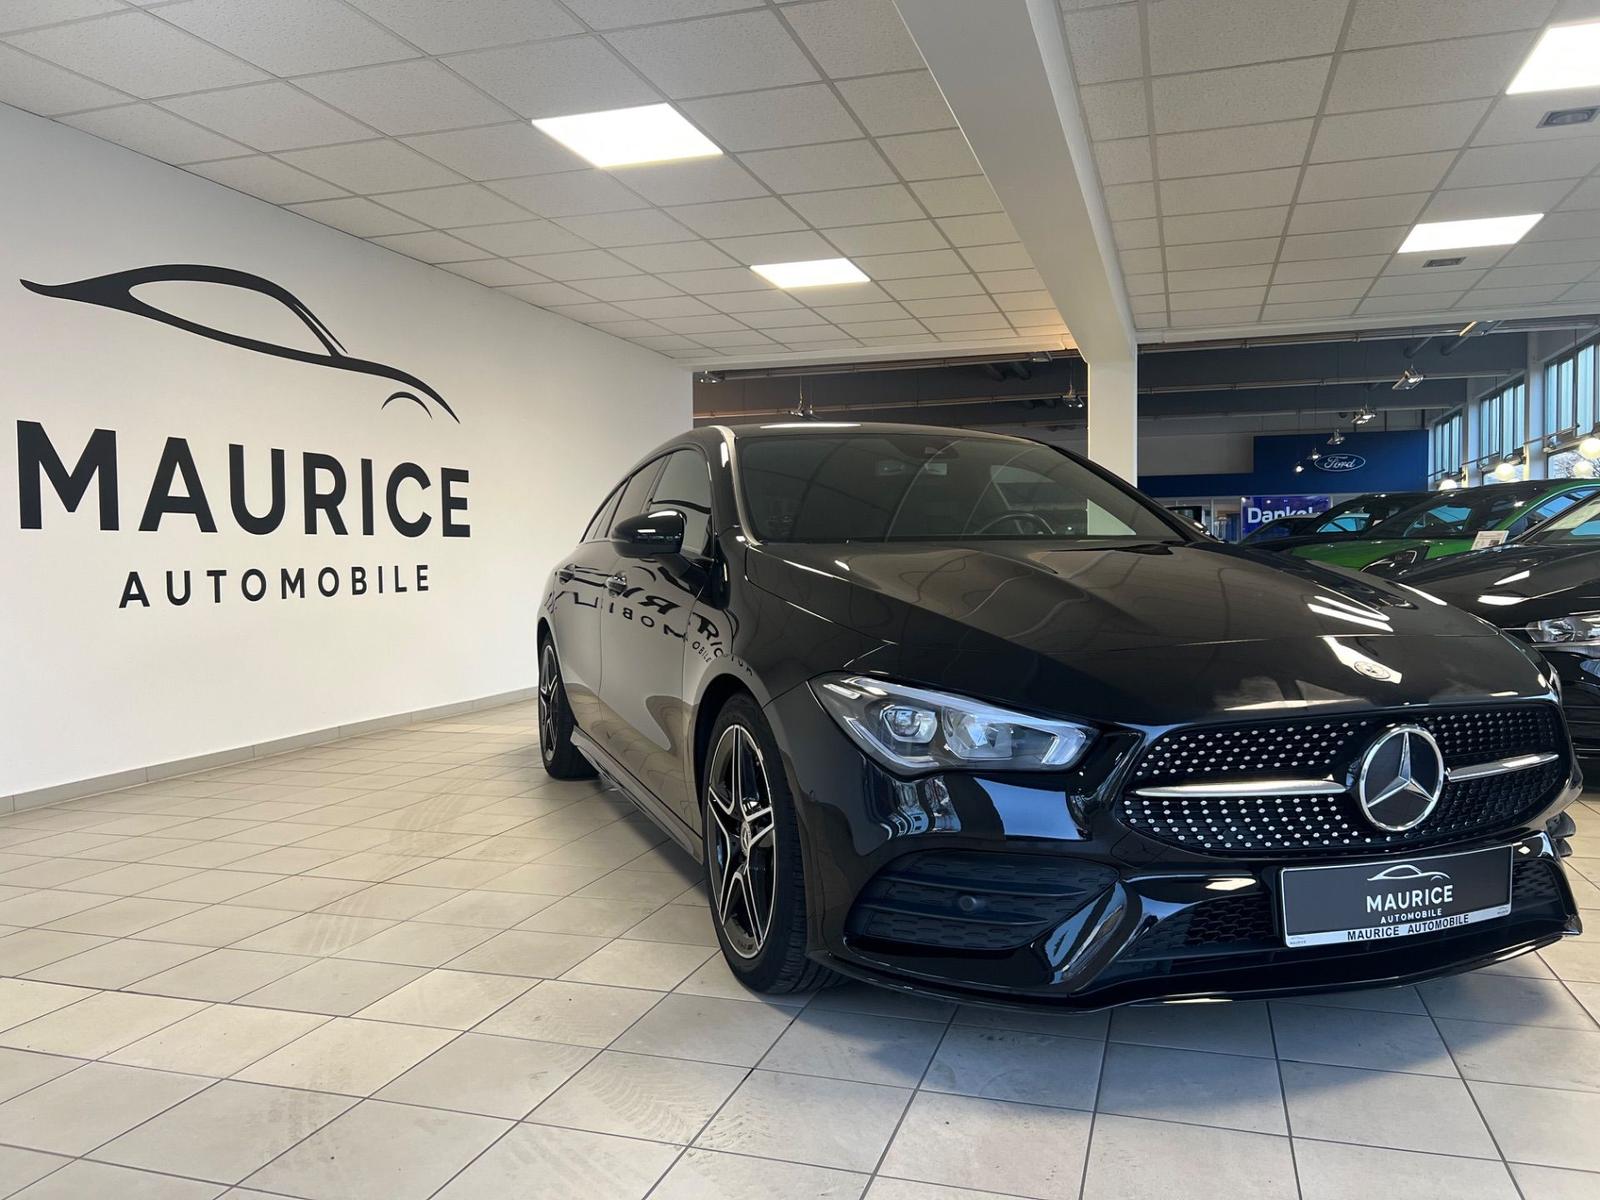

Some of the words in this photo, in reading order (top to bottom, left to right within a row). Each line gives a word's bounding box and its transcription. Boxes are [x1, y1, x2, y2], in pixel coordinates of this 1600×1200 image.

[1324, 456, 1356, 469] Ford
[16, 420, 471, 538] MAURICE
[1247, 506, 1313, 524] Dank
[119, 564, 430, 609] AUTOMOBILE
[1366, 885, 1454, 913] MAURICE
[1347, 926, 1400, 941] MAURICE
[1407, 914, 1469, 934] AUTOMOBILE
[1380, 908, 1443, 924] AUTOMOBILE
